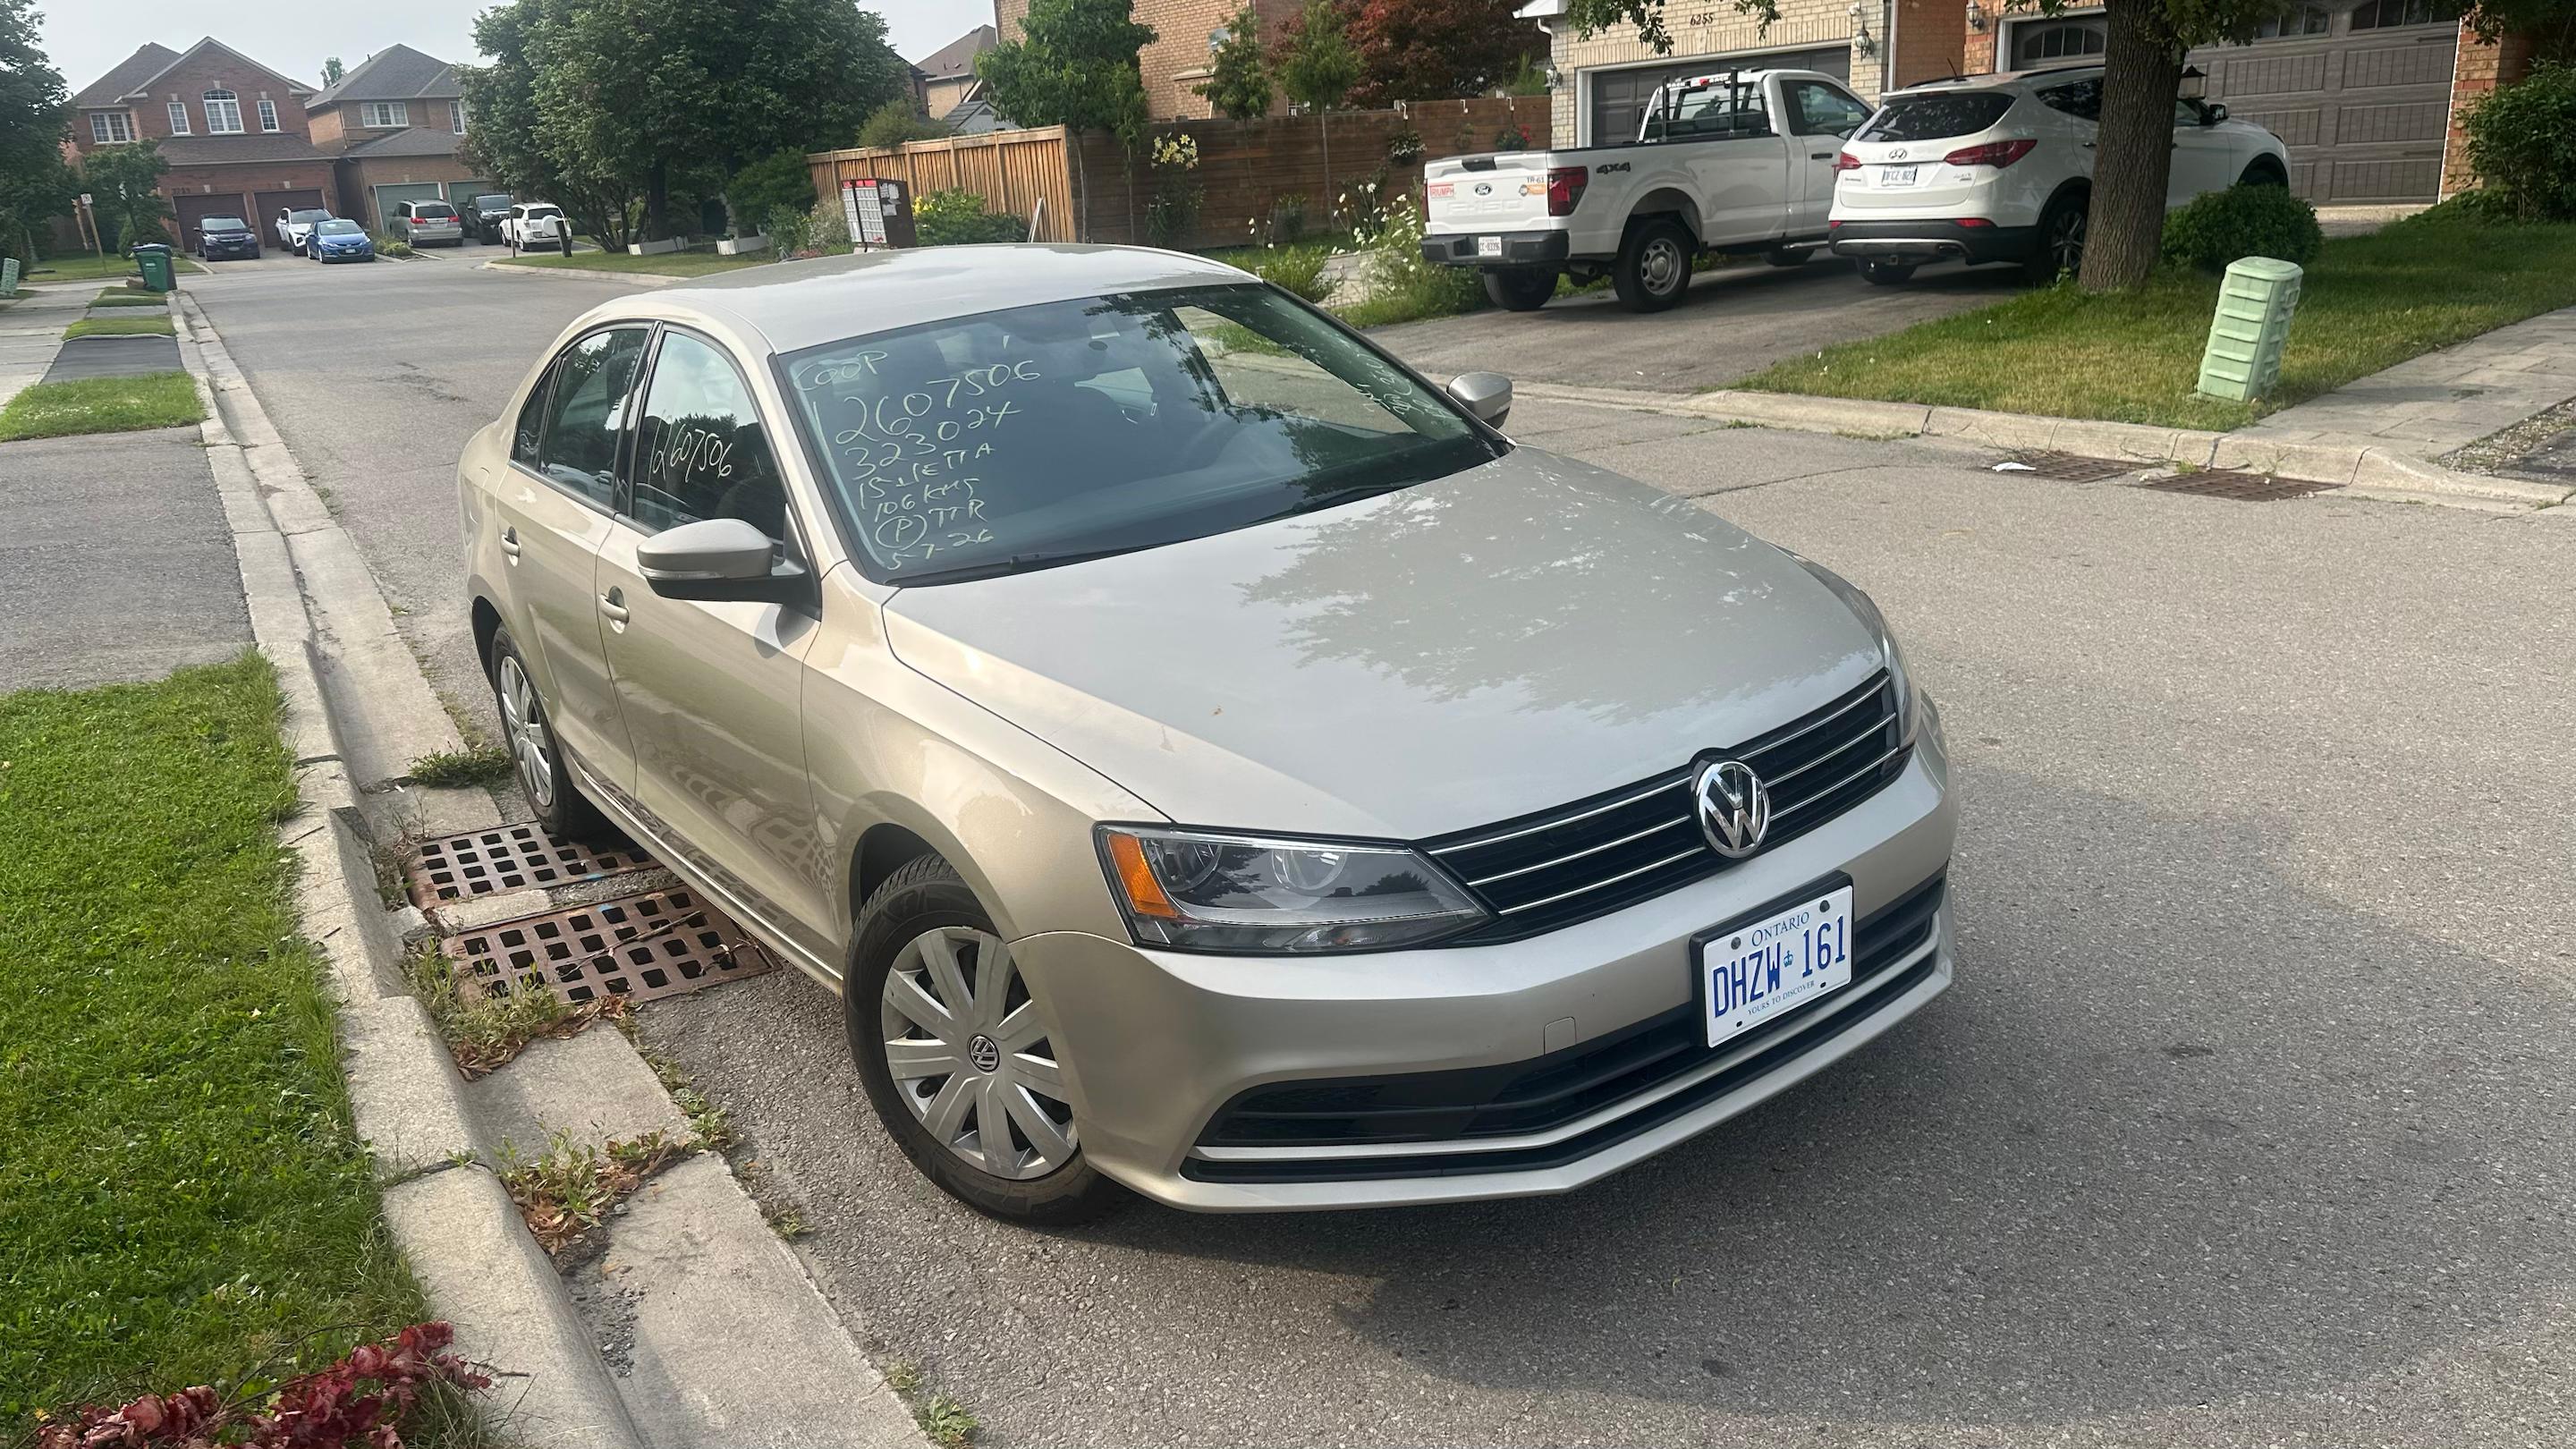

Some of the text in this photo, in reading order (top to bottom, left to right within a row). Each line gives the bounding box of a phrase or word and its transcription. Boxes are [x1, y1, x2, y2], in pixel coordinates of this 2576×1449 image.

[1690, 13, 1714, 26] 6255
[835, 360, 1041, 445] 2607506
[845, 400, 1024, 480] 323024
[874, 493, 916, 523] 106
[1751, 911, 1810, 947] ONTARIO
[1713, 915, 1846, 1019] DHZW 161
[1748, 980, 1816, 1016] YOURS TO DISCOVER
